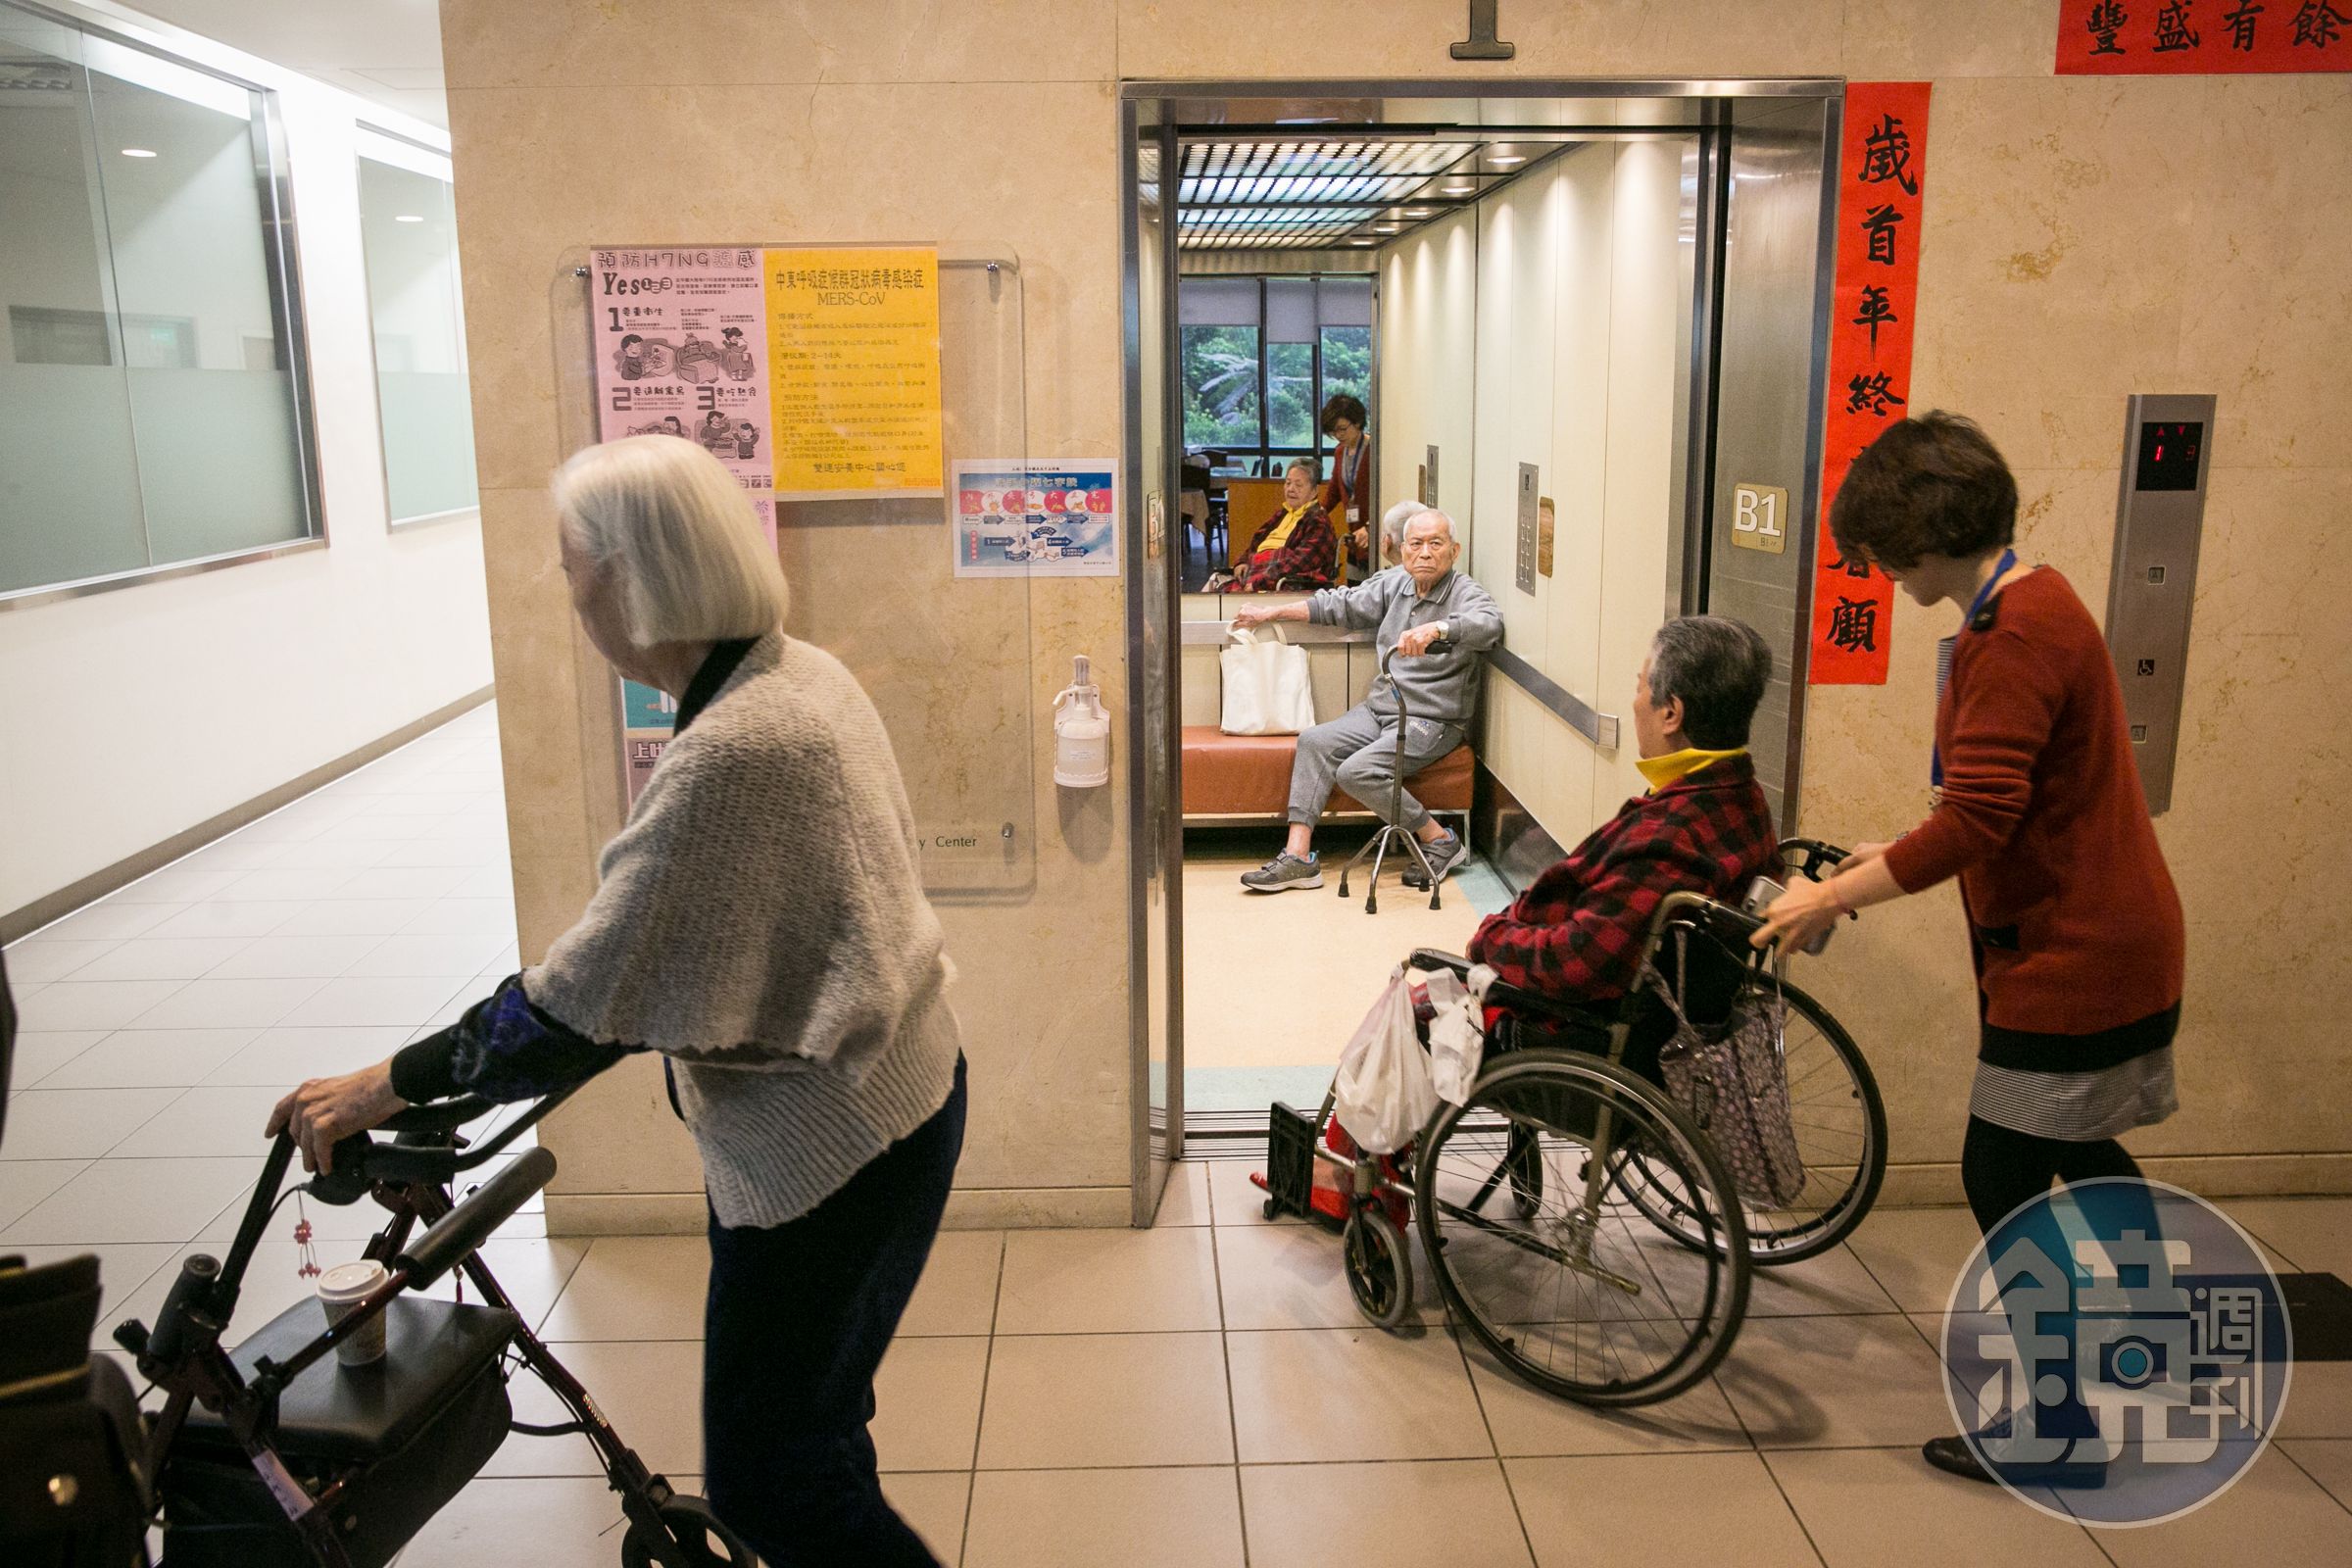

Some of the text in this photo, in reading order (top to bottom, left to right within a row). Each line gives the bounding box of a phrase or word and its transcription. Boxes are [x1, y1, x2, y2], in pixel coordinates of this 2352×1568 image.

[2086, 0, 2352, 55] 豐盛有餘
[817, 291, 886, 306] MERS-CoV
[1827, 114, 1919, 654] 歲首年終顧
[1735, 489, 1781, 537] B1
[935, 836, 977, 847] Center
